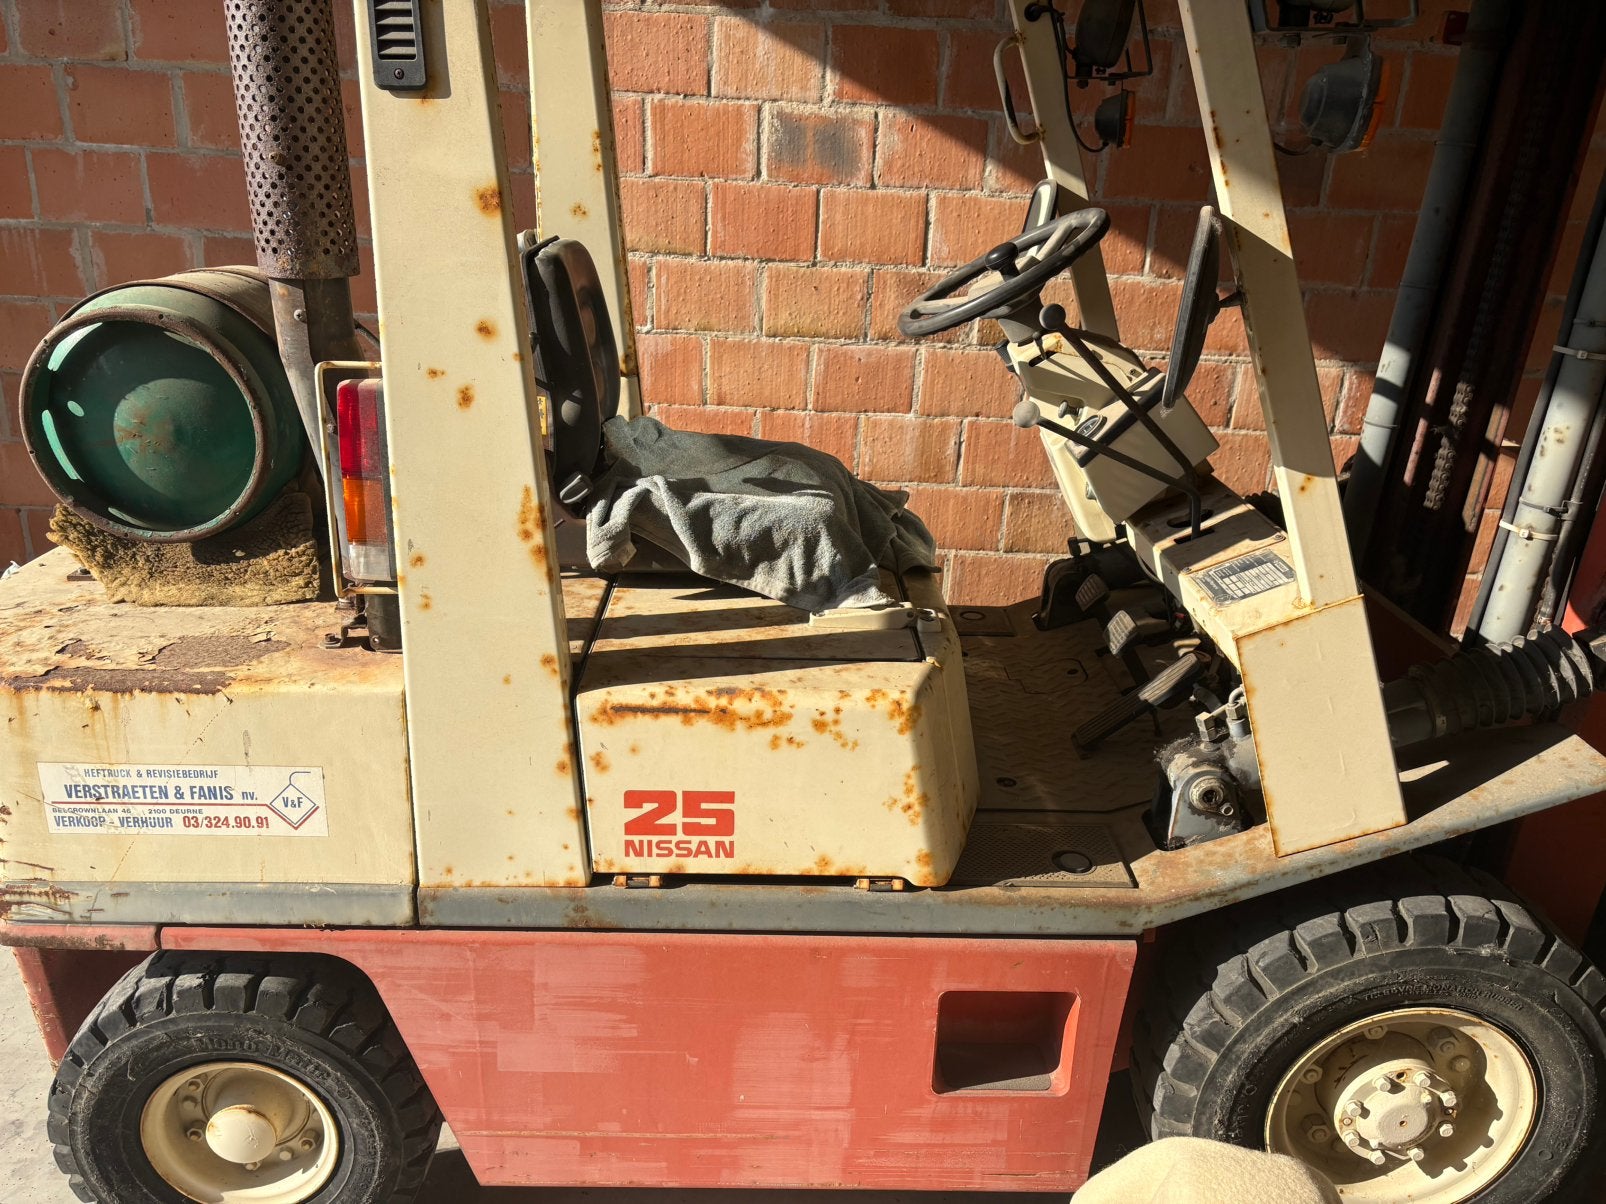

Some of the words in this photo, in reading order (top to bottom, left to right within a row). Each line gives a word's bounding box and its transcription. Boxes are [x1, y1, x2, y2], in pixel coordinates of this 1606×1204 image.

[84, 769, 132, 778] HEFTRUCK
[136, 769, 143, 778] &
[146, 769, 219, 779] REVISIEBEDRIJF
[64, 784, 170, 800] VERSTRAETEN
[174, 785, 185, 800] &
[190, 785, 234, 801] FANIS
[242, 791, 258, 801] nv.
[623, 790, 735, 836] 25
[54, 815, 106, 828] VERKOOP
[119, 816, 174, 828] VERHUUR
[183, 815, 270, 829] 03/324.90.91
[624, 840, 734, 858] NISSAN
